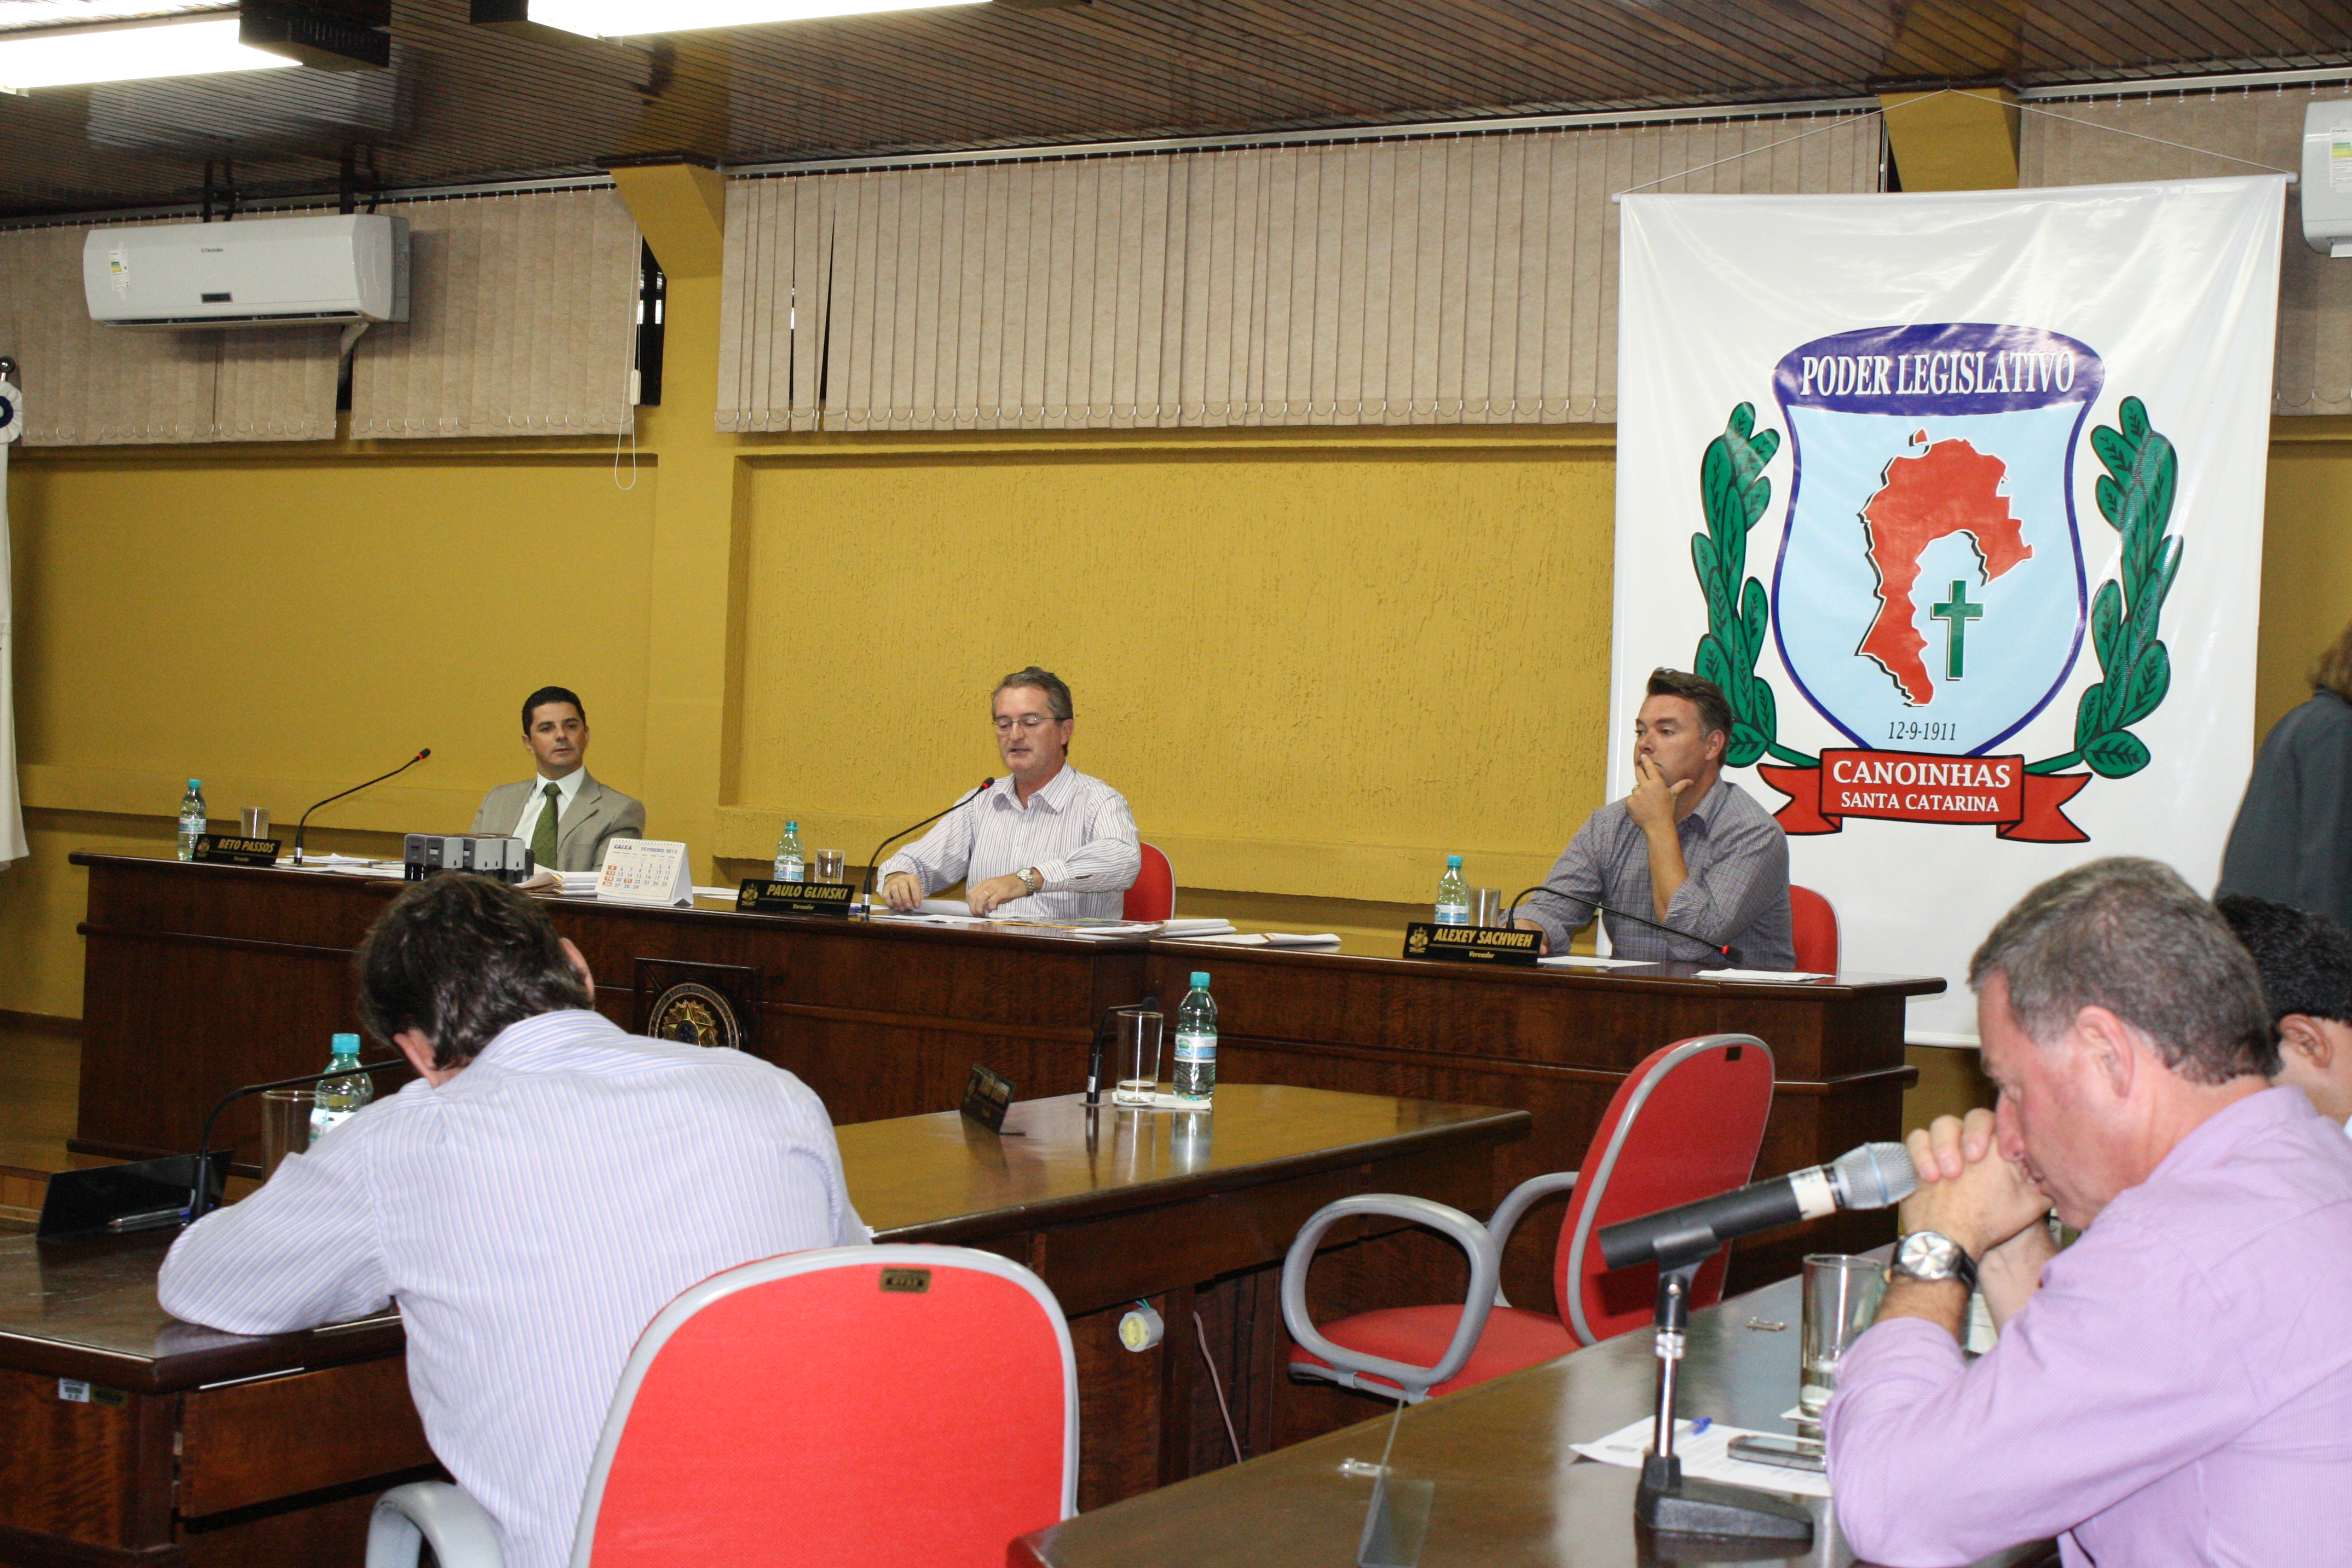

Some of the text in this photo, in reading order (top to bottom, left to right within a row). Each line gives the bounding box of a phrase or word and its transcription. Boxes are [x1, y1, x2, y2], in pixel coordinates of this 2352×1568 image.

[1800, 350, 2076, 396] PODER LEGISLATIVO
[1888, 721, 1956, 740] 12-9-1911
[1832, 760, 2010, 788] CANOINHAS
[1841, 791, 1999, 812] SANTA CATARINA
[218, 838, 275, 853] BETO PASSOS
[766, 884, 848, 900] PAULO GLINSKI
[1434, 928, 1534, 947] ALEXEY SACHWEH
